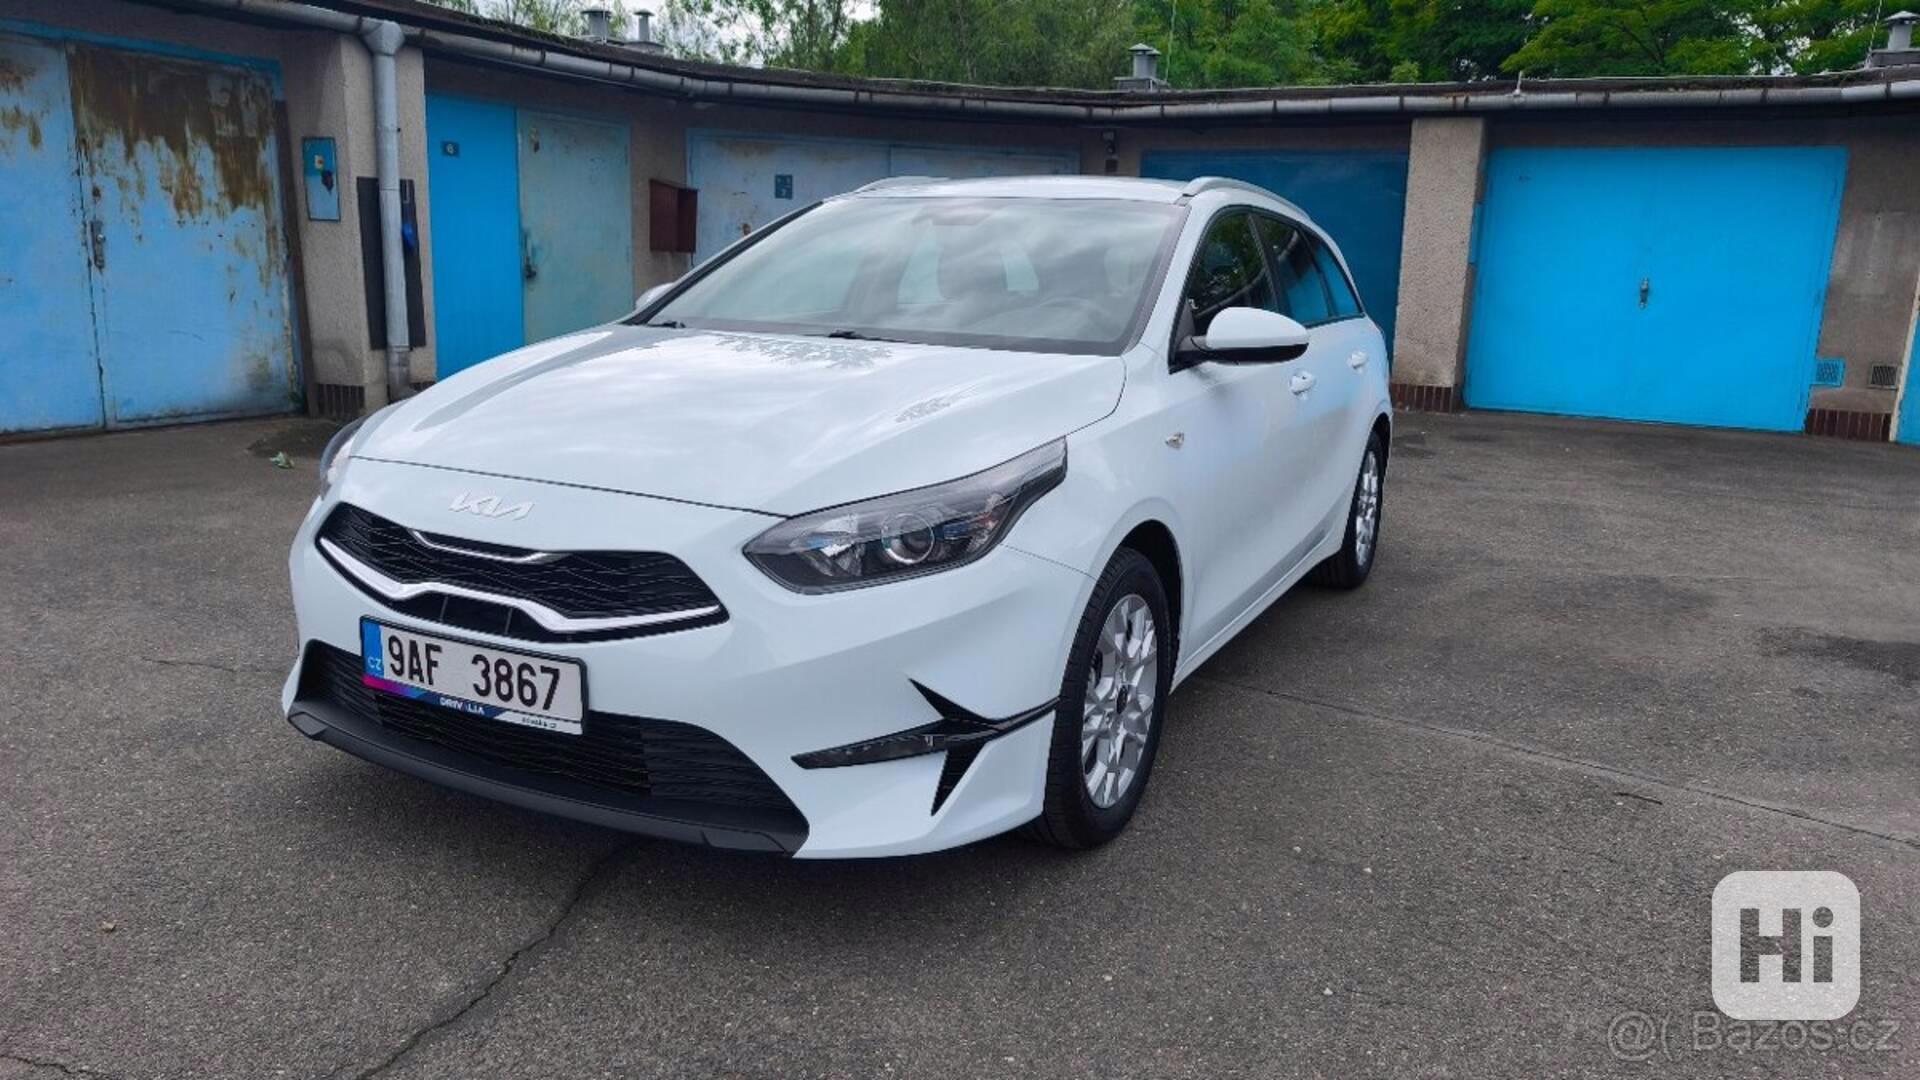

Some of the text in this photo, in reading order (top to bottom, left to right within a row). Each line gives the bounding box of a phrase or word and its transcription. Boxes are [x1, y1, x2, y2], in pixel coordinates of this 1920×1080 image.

[448, 489, 535, 520] KIA
[367, 656, 381, 670] CZ
[388, 635, 560, 710] 9AF 3867
